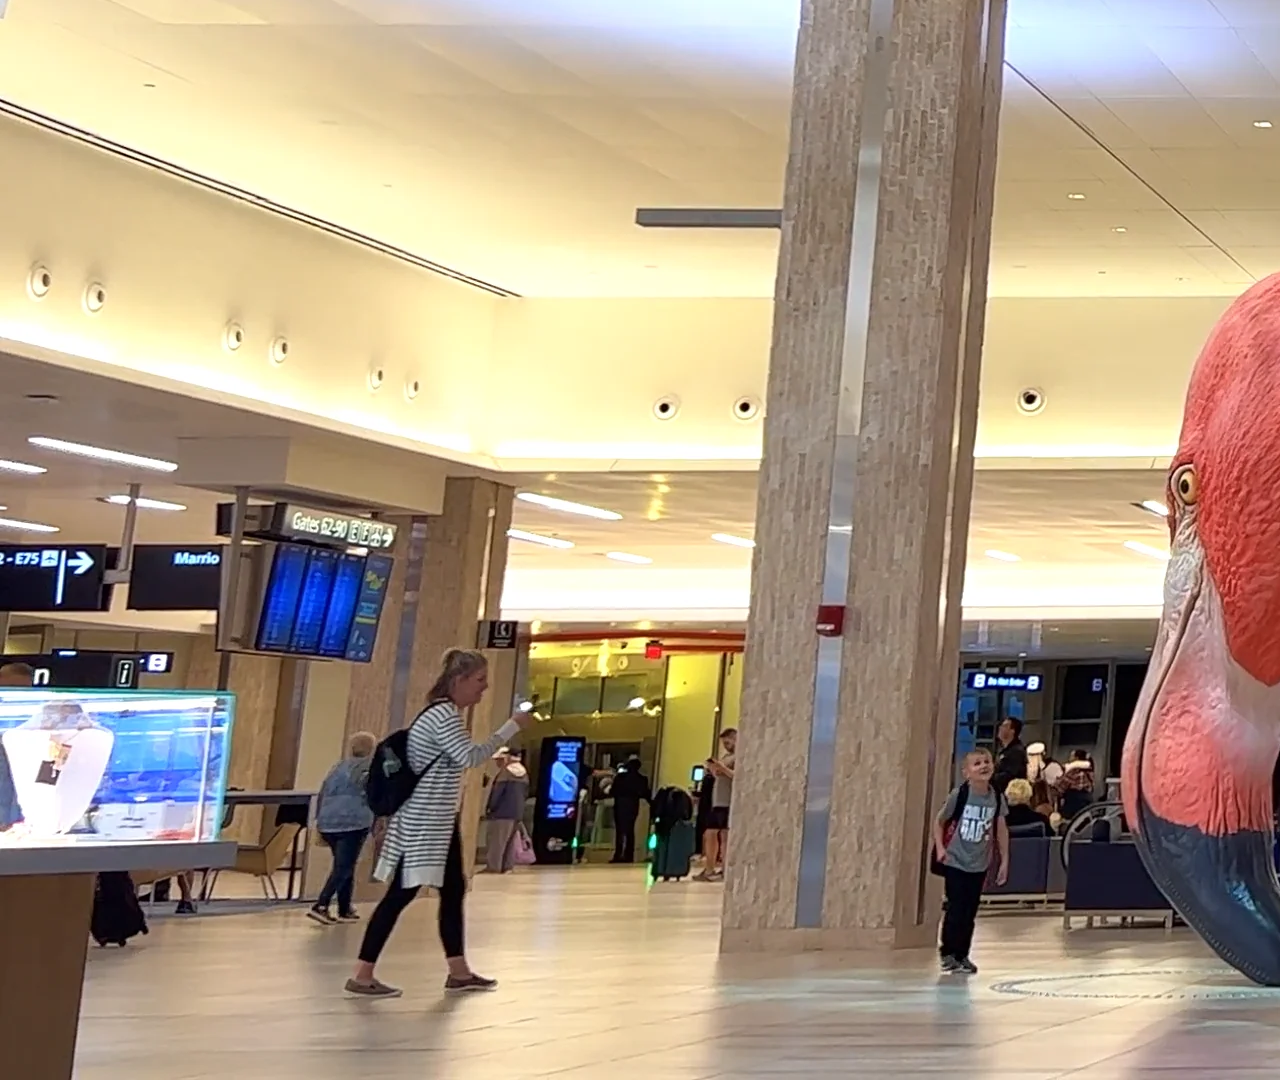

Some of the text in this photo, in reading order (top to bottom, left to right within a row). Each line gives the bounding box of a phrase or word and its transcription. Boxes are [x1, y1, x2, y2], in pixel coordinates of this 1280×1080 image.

[292, 512, 319, 533] Gates
[15, 552, 39, 565] E75
[174, 552, 220, 565] Marrio
